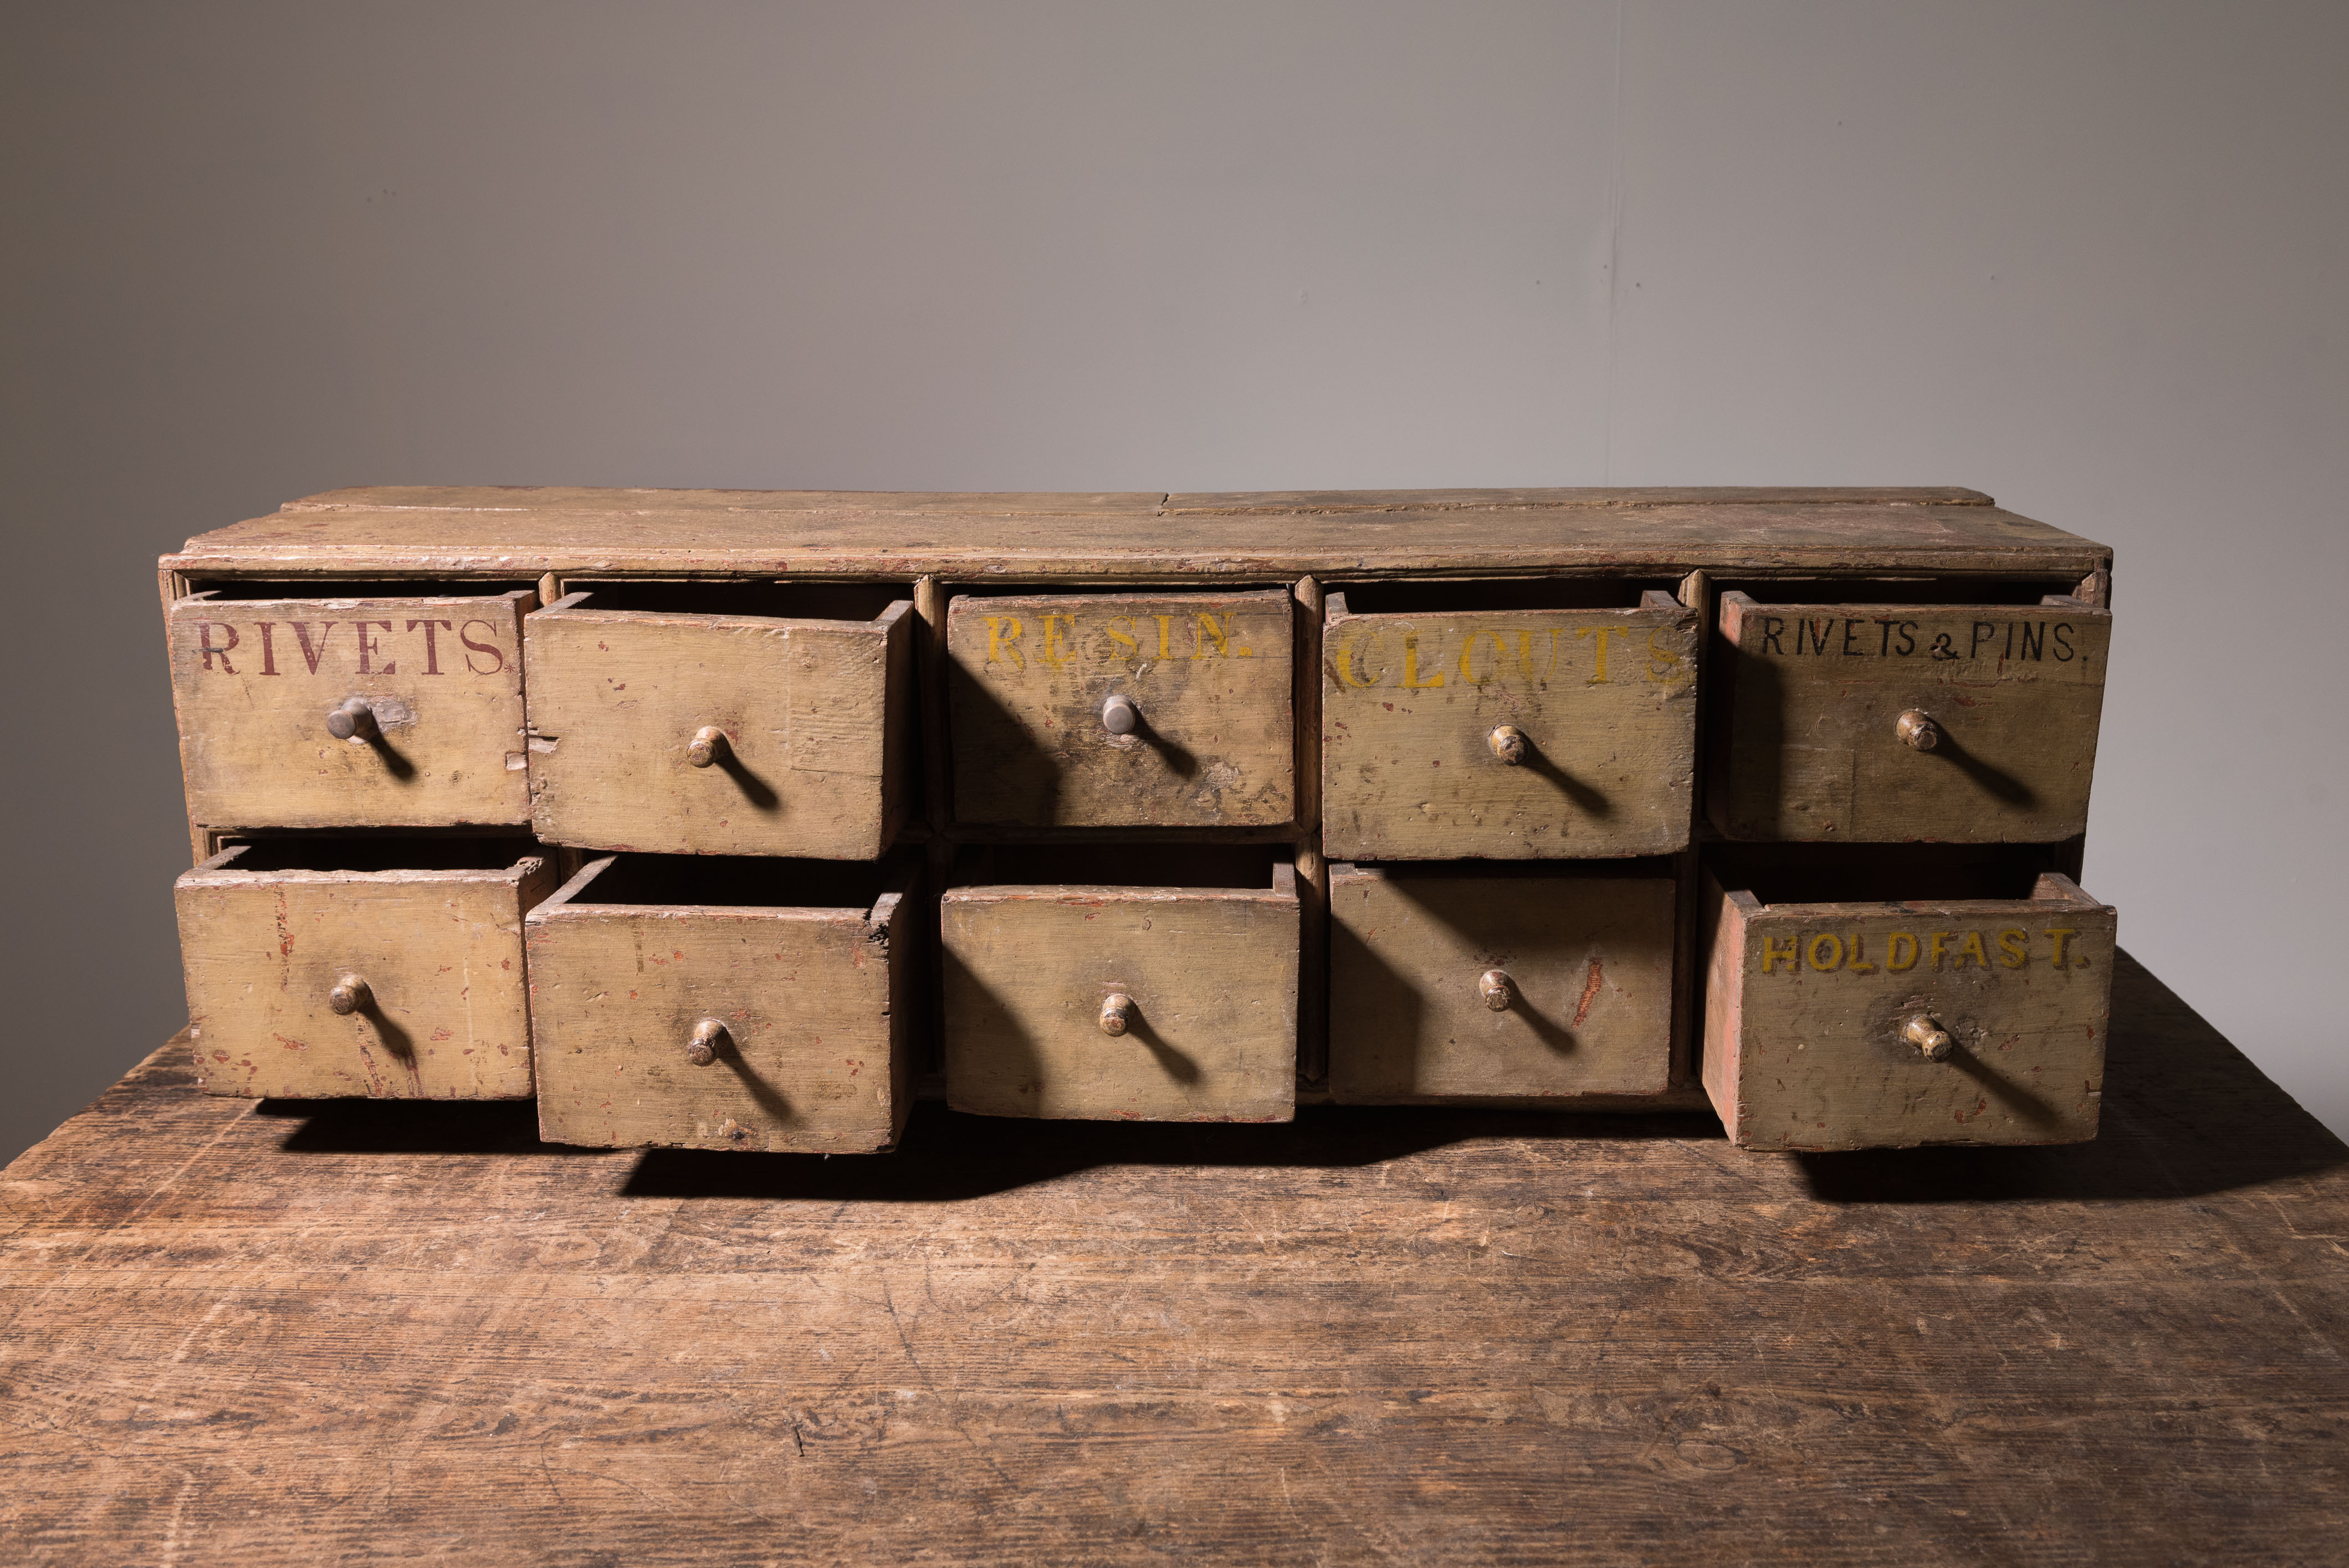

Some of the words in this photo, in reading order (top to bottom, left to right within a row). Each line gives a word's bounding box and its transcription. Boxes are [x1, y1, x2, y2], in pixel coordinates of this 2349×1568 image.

[196, 619, 504, 676] RIVETS
[981, 611, 1252, 671] RESIN.
[1762, 616, 1919, 658] RIVETS
[1930, 633, 1960, 661] &
[1970, 620, 2089, 662] PINS.
[1762, 928, 2090, 975] HOLDFAST.
